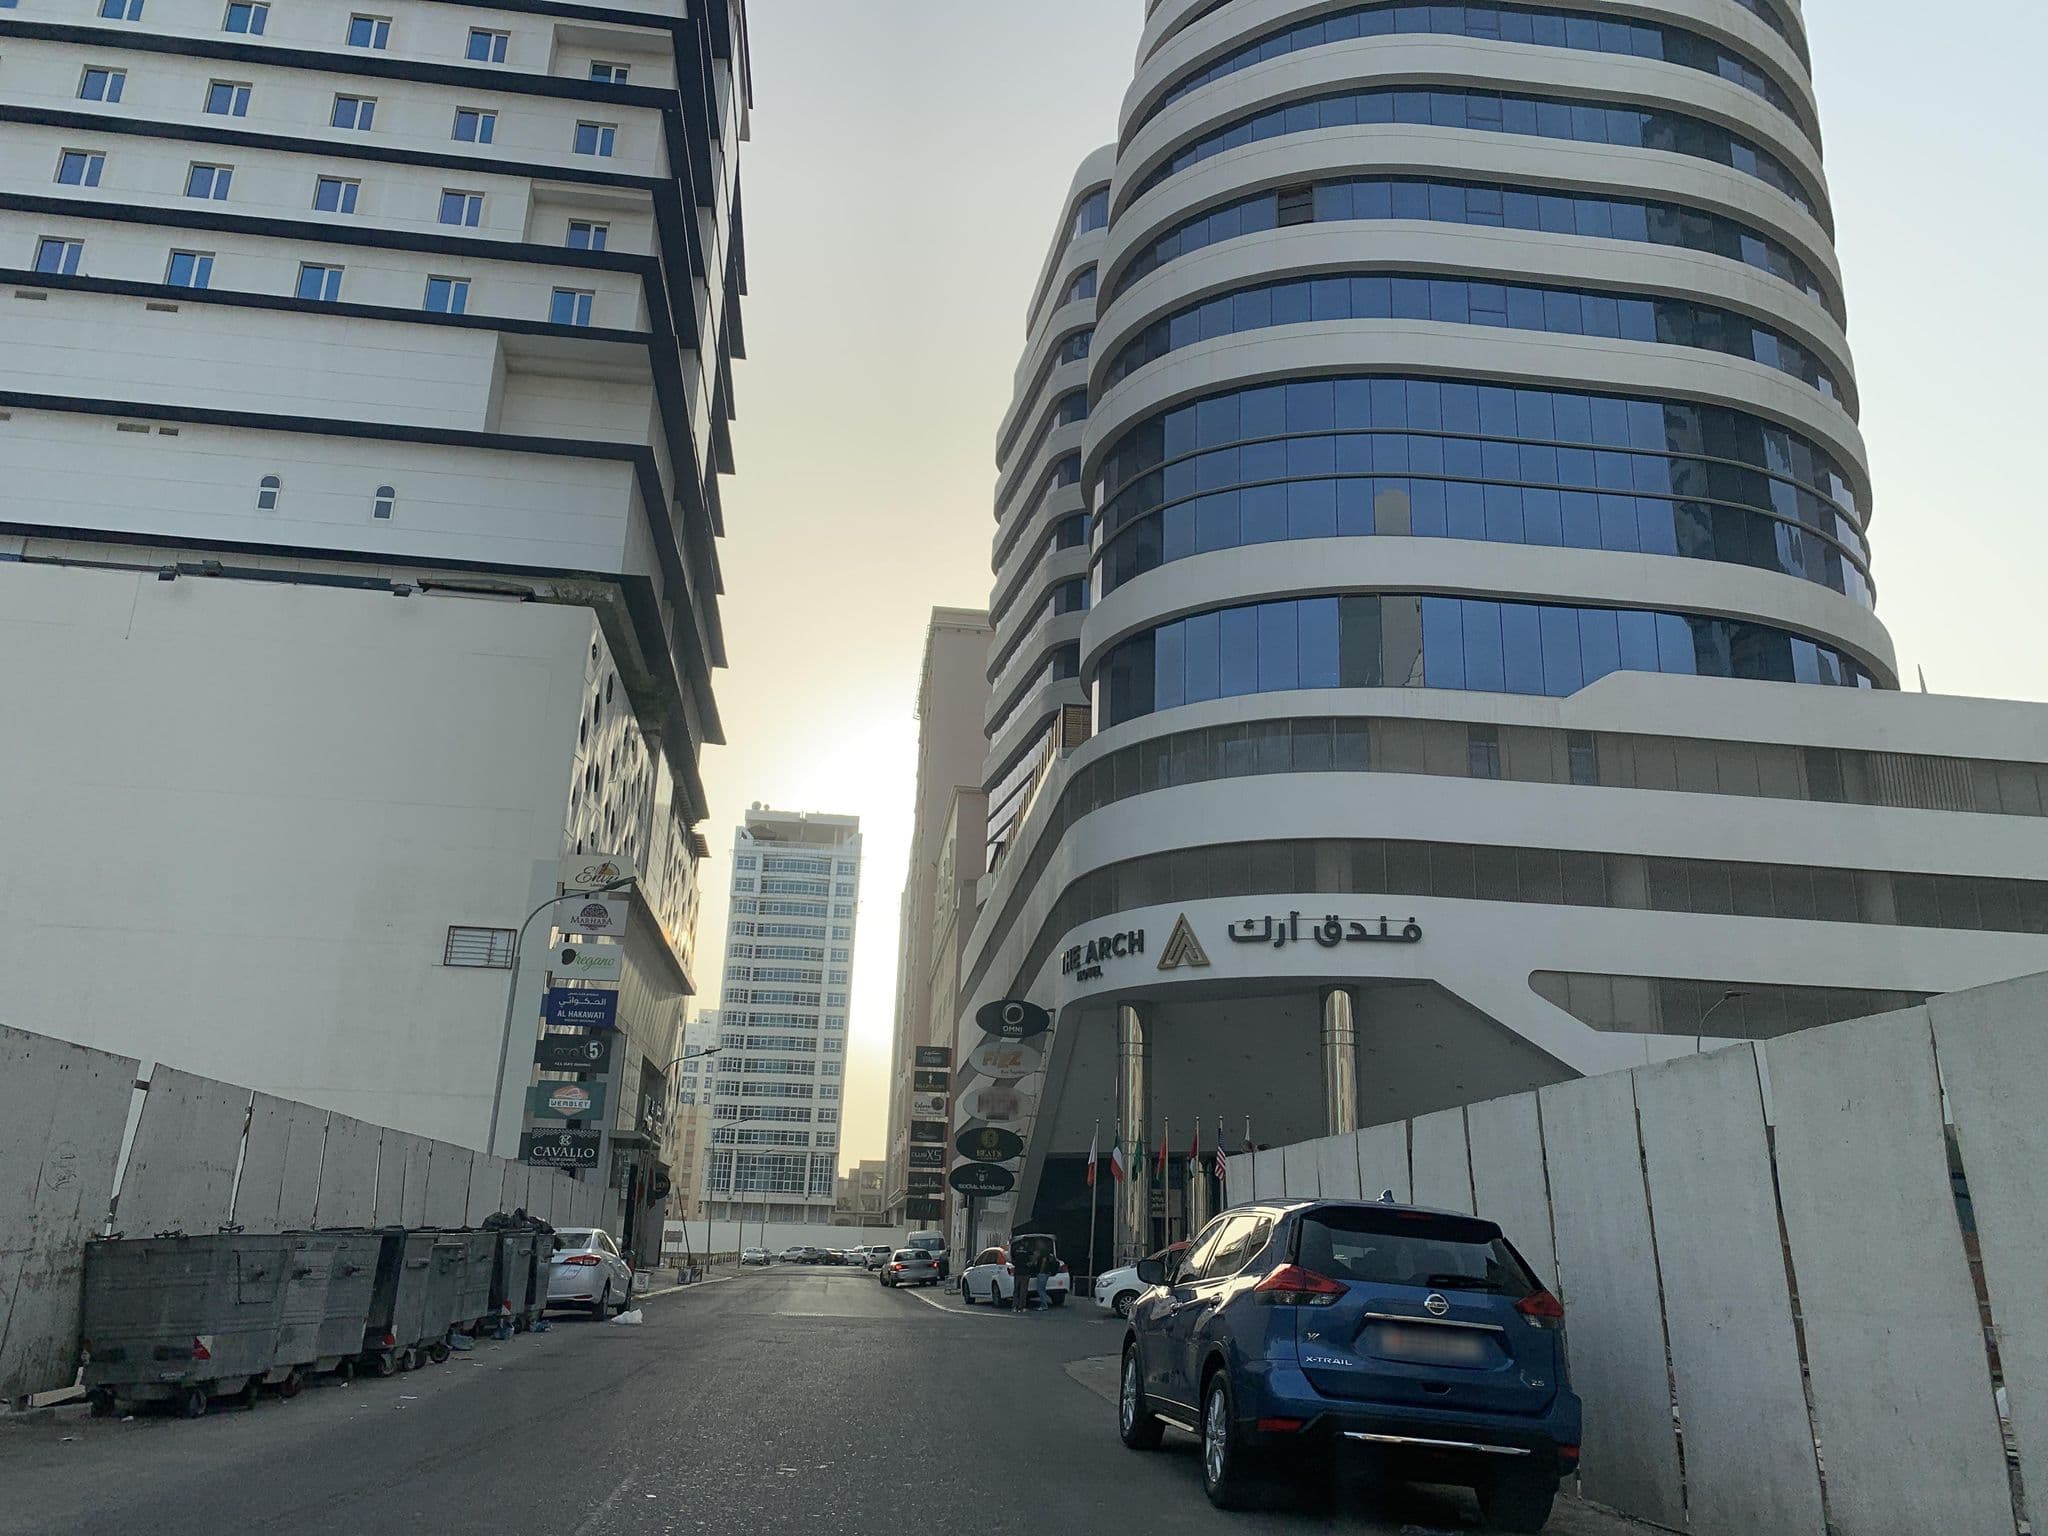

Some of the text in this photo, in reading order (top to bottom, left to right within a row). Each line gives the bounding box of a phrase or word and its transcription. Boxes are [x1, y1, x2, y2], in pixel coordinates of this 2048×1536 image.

[570, 915, 613, 926] MARHABA
[1314, 915, 1422, 948] فندق
[1085, 929, 1144, 964] ARCH
[568, 1011, 605, 1020] HAKAWATI
[1002, 1025, 1023, 1033] OMNI
[589, 1041, 599, 1059] 5
[550, 1100, 589, 1108] WEMBLEY
[533, 1146, 595, 1158] CAVALLO
[1305, 1355, 1353, 1366] X-TRAIL
